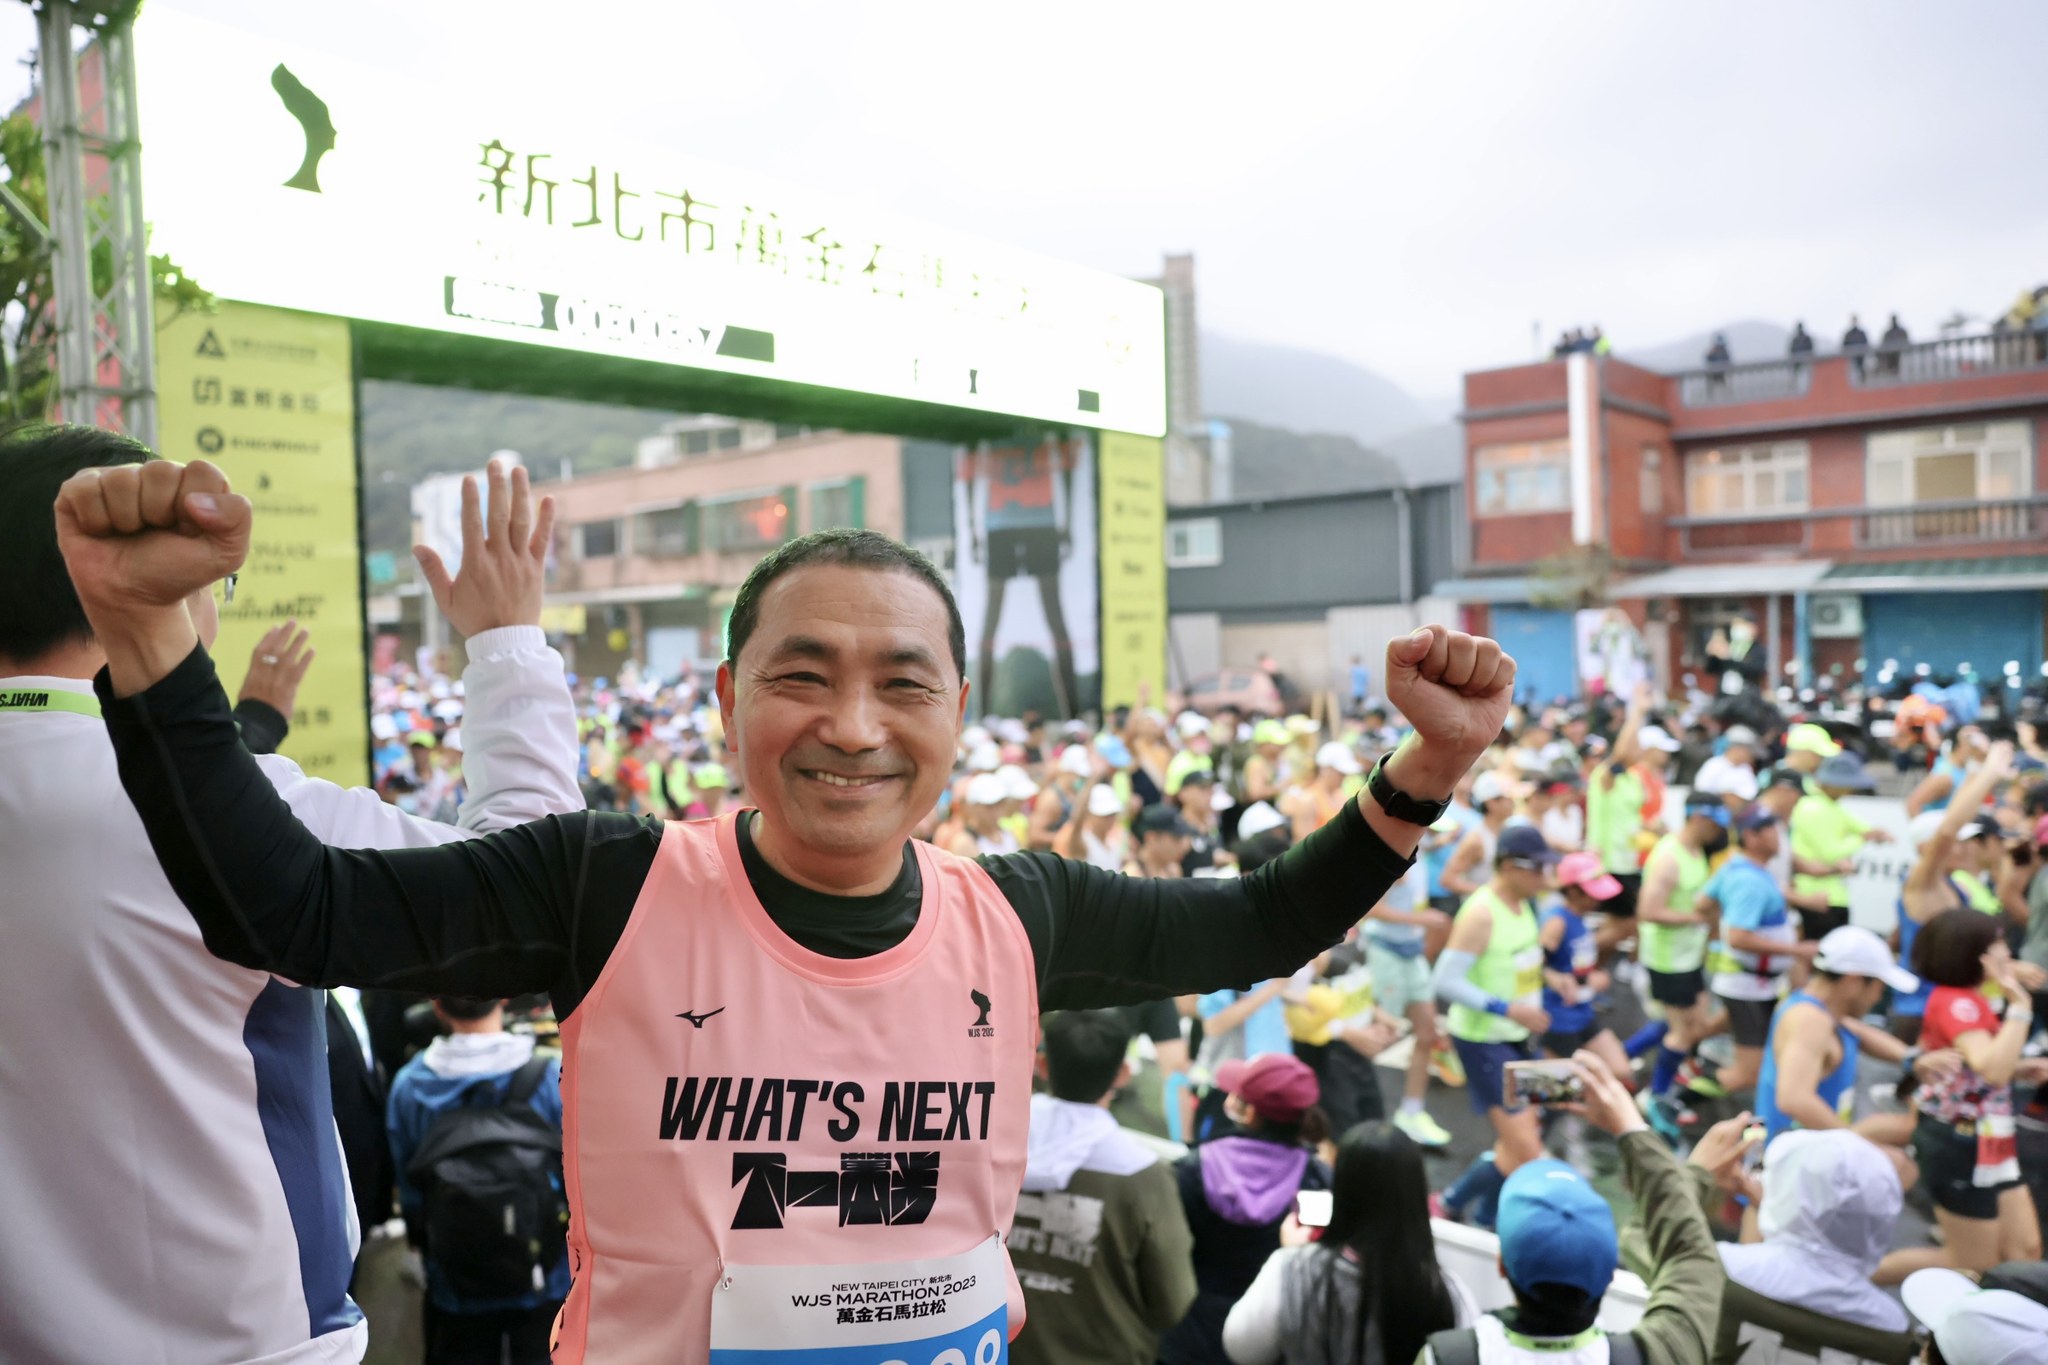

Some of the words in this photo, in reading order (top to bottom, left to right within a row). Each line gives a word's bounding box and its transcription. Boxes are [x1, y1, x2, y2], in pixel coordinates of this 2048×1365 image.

[967, 1028, 980, 1038] WJS
[659, 1077, 865, 1142] WHAT'S
[877, 1081, 996, 1142] NEXT
[791, 1294, 832, 1307] WJS
[836, 1285, 940, 1305] MARATHON
[942, 1275, 976, 1295] 2023
[832, 1283, 860, 1292] NEW
[862, 1281, 899, 1290] TAIPEI
[901, 1278, 926, 1288] CITY
[929, 1274, 952, 1284] 新北市
[836, 1299, 946, 1324] 萬金石馬拉松
